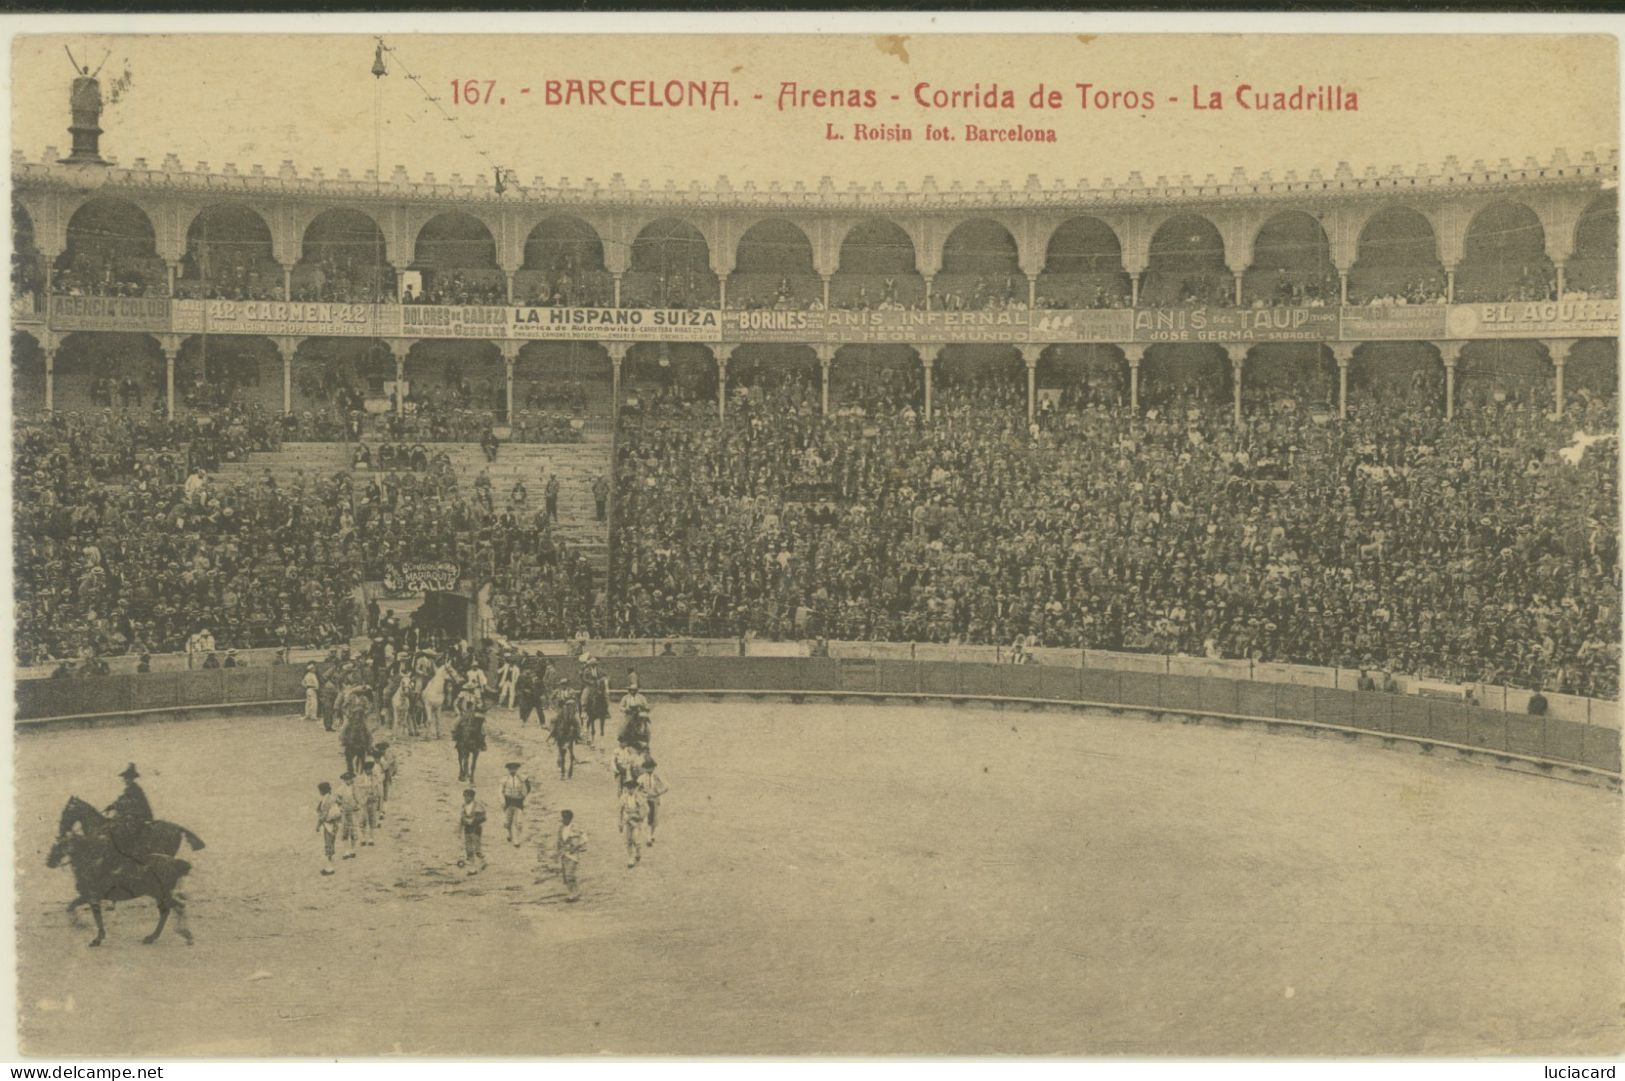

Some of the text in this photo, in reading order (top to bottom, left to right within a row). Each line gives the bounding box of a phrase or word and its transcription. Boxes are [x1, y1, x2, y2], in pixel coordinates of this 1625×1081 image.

[210, 301, 237, 321] 42
[247, 302, 334, 323] CARMEN
[340, 304, 368, 324] 42
[403, 306, 450, 326] DOLORES
[515, 309, 541, 323] LA
[550, 309, 642, 325] HISPANO
[654, 311, 717, 326] SUIZA
[740, 311, 808, 329] BORINES
[902, 312, 1029, 325] INFERNAL
[1481, 303, 1516, 324] EL
[862, 332, 917, 341] PEOR
[951, 332, 1029, 341] MUNDO
[408, 580, 454, 591] GALLO
